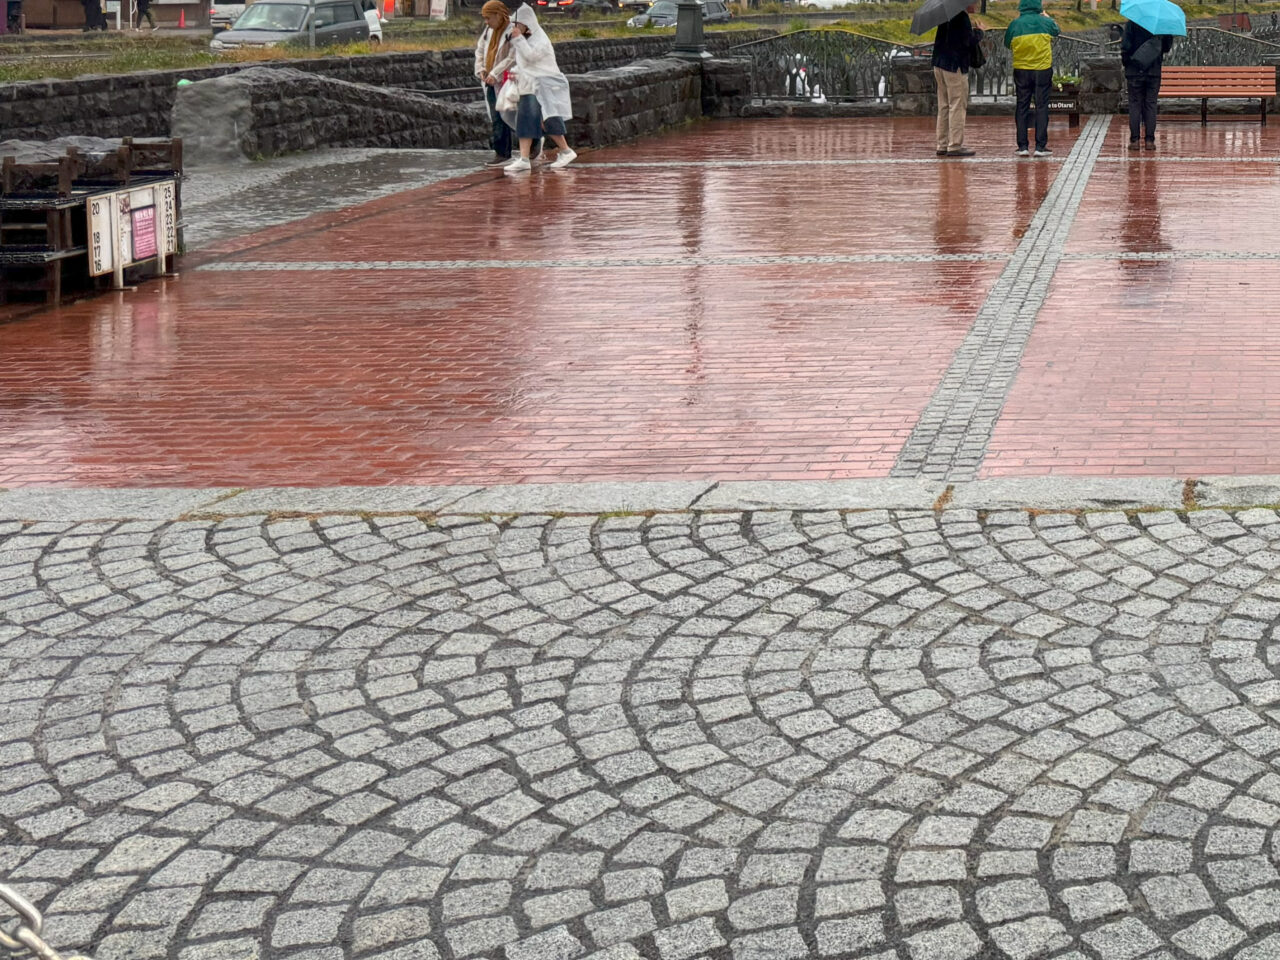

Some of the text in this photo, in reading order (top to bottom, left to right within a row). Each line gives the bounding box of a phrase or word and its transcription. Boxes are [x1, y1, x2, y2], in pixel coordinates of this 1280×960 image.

[164, 186, 172, 199] 25
[92, 202, 100, 216] 20
[165, 201, 173, 213] 24
[166, 213, 173, 226] 23
[93, 246, 101, 258] 17
